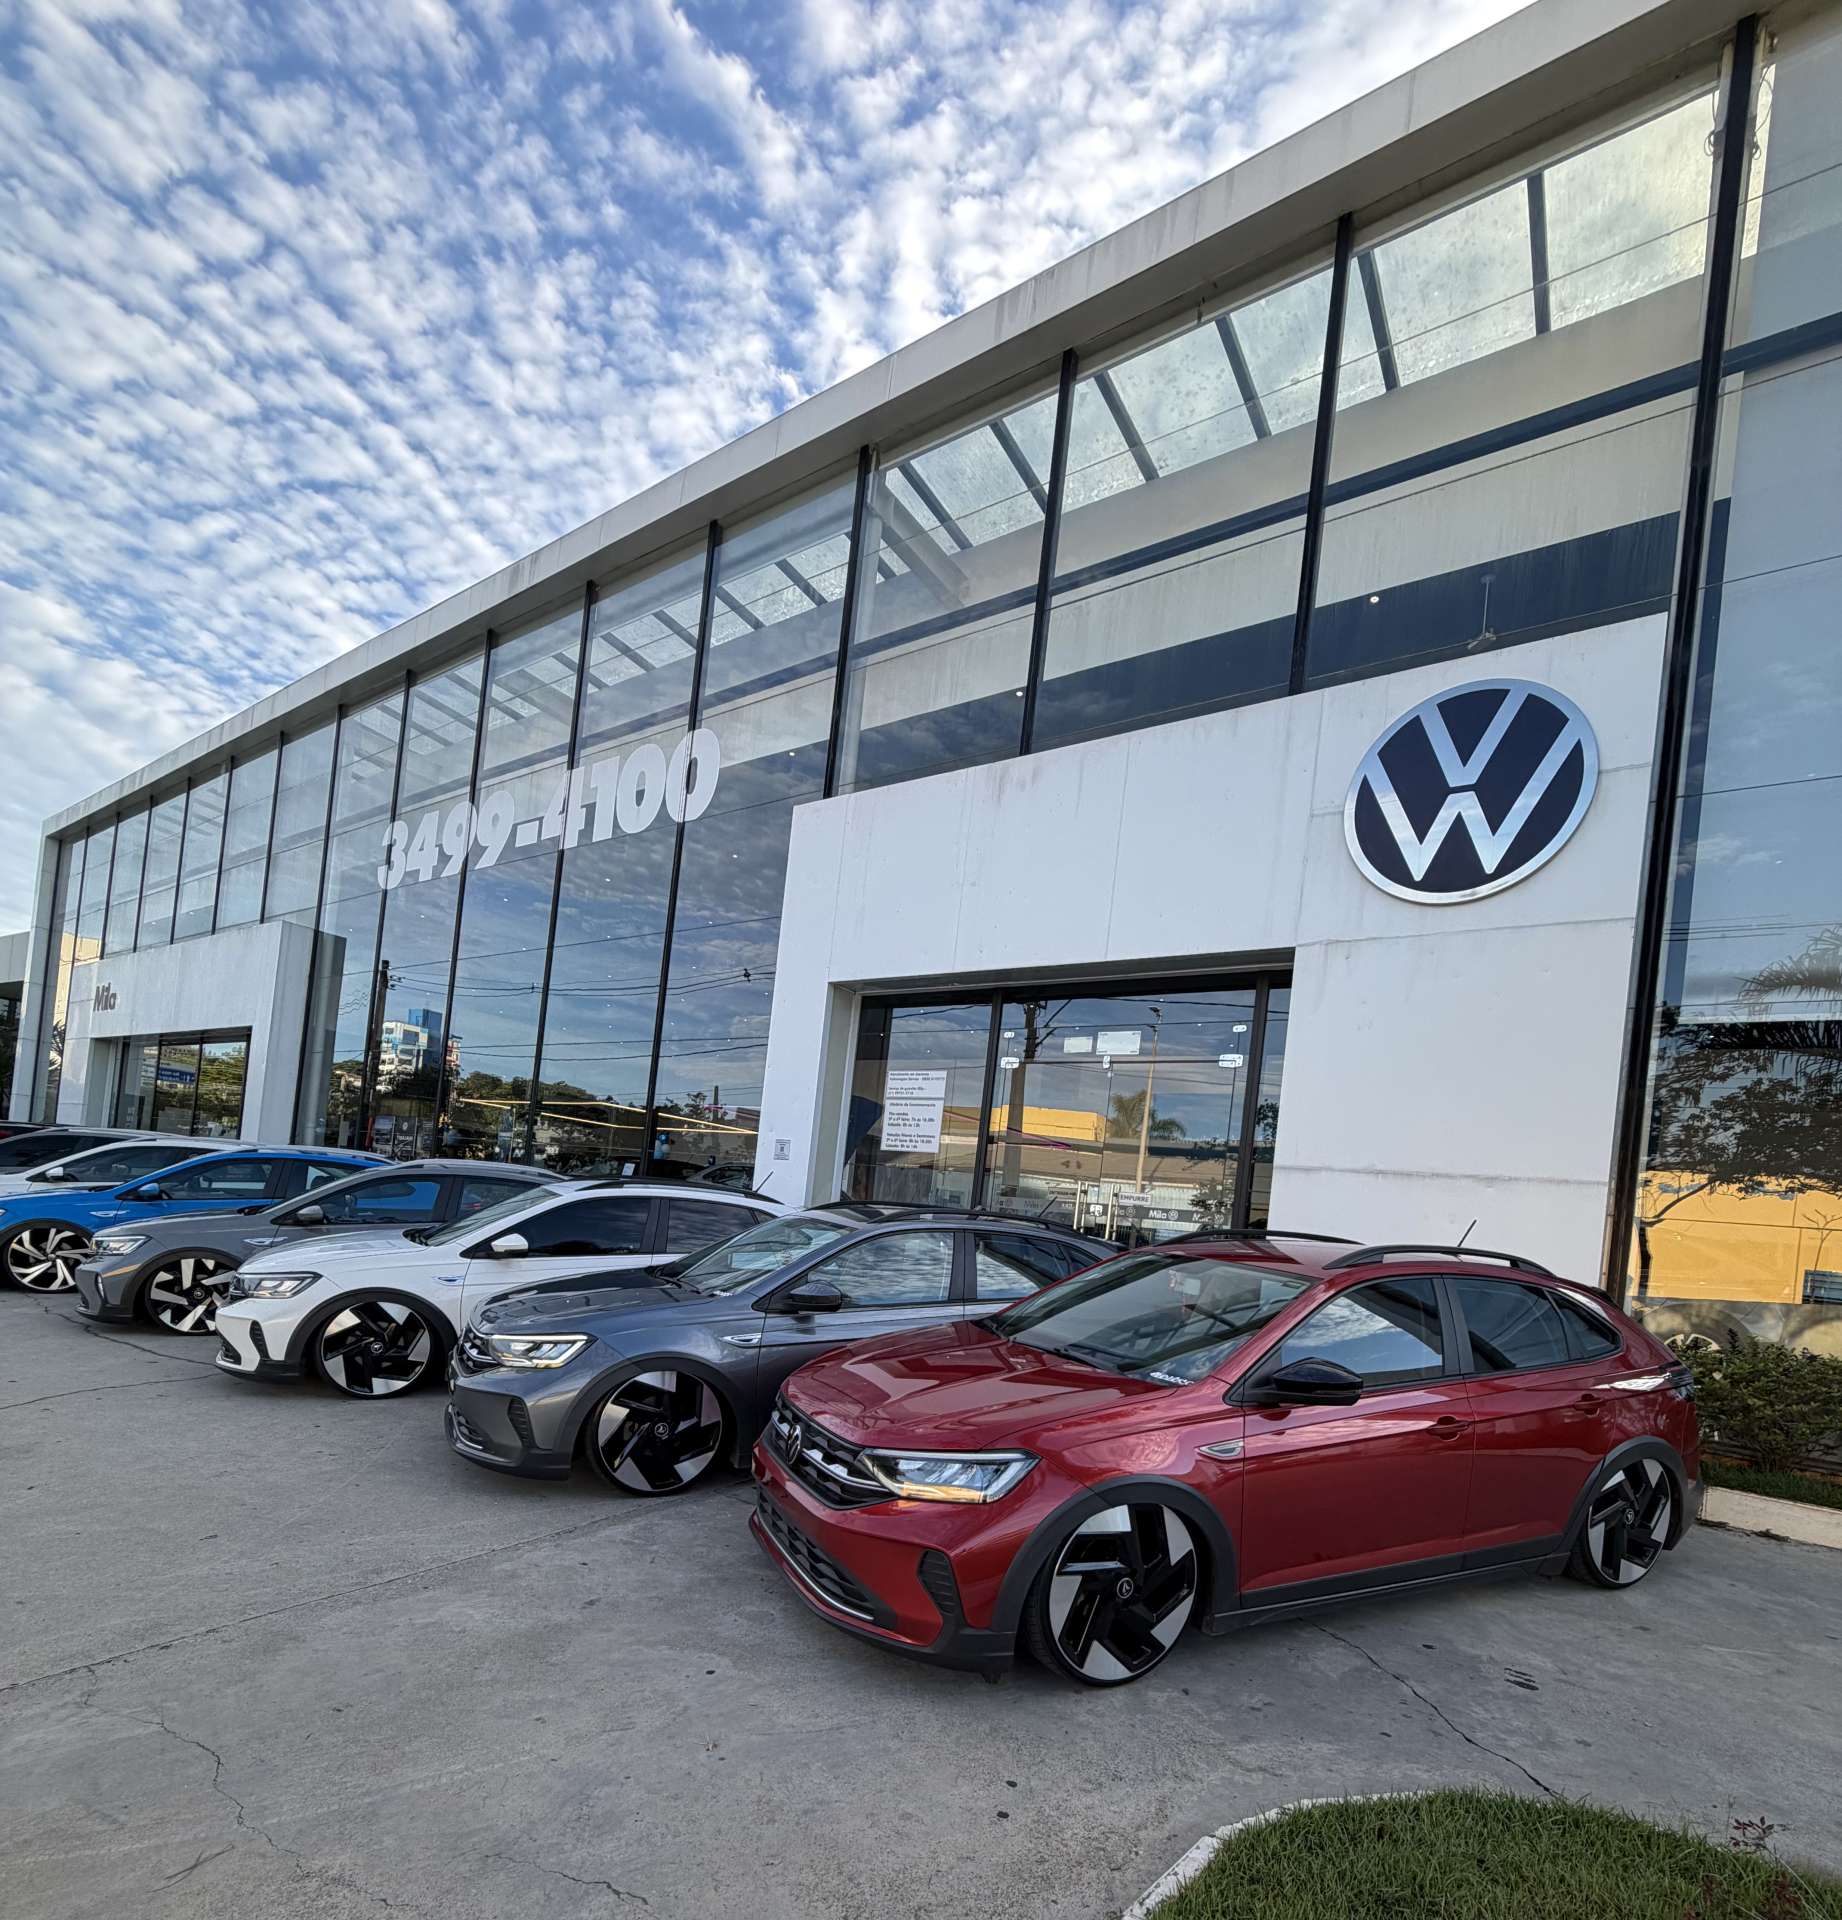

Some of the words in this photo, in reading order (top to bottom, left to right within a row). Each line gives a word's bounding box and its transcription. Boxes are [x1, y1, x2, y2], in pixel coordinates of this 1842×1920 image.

[377, 728, 721, 890] 3499-4100
[92, 981, 117, 1012] Mila
[1120, 1194, 1150, 1203] EMPURRE
[1148, 1209, 1168, 1219] Mila
